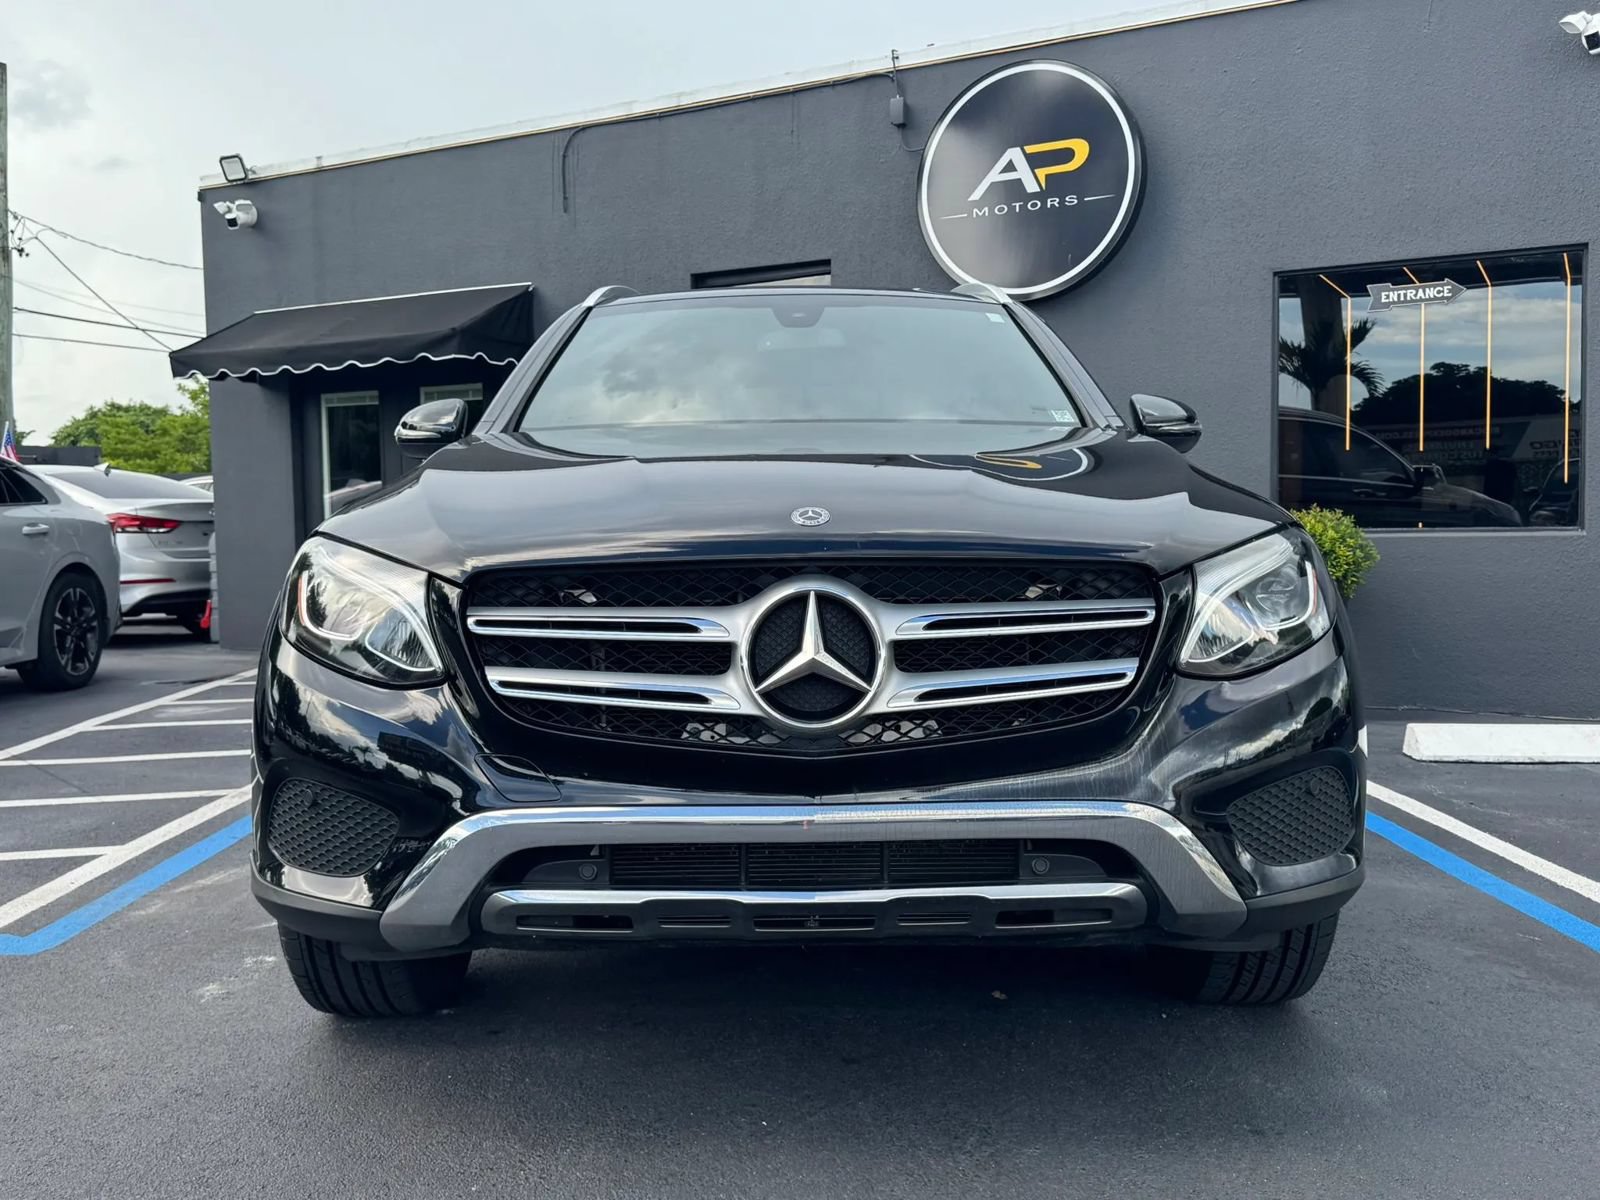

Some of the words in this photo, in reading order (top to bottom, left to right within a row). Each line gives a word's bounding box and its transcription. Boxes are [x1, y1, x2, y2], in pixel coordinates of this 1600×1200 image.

[968, 138, 1090, 201] AP
[972, 195, 1078, 218] MOTORS
[1381, 286, 1452, 302] ENTRANCE
